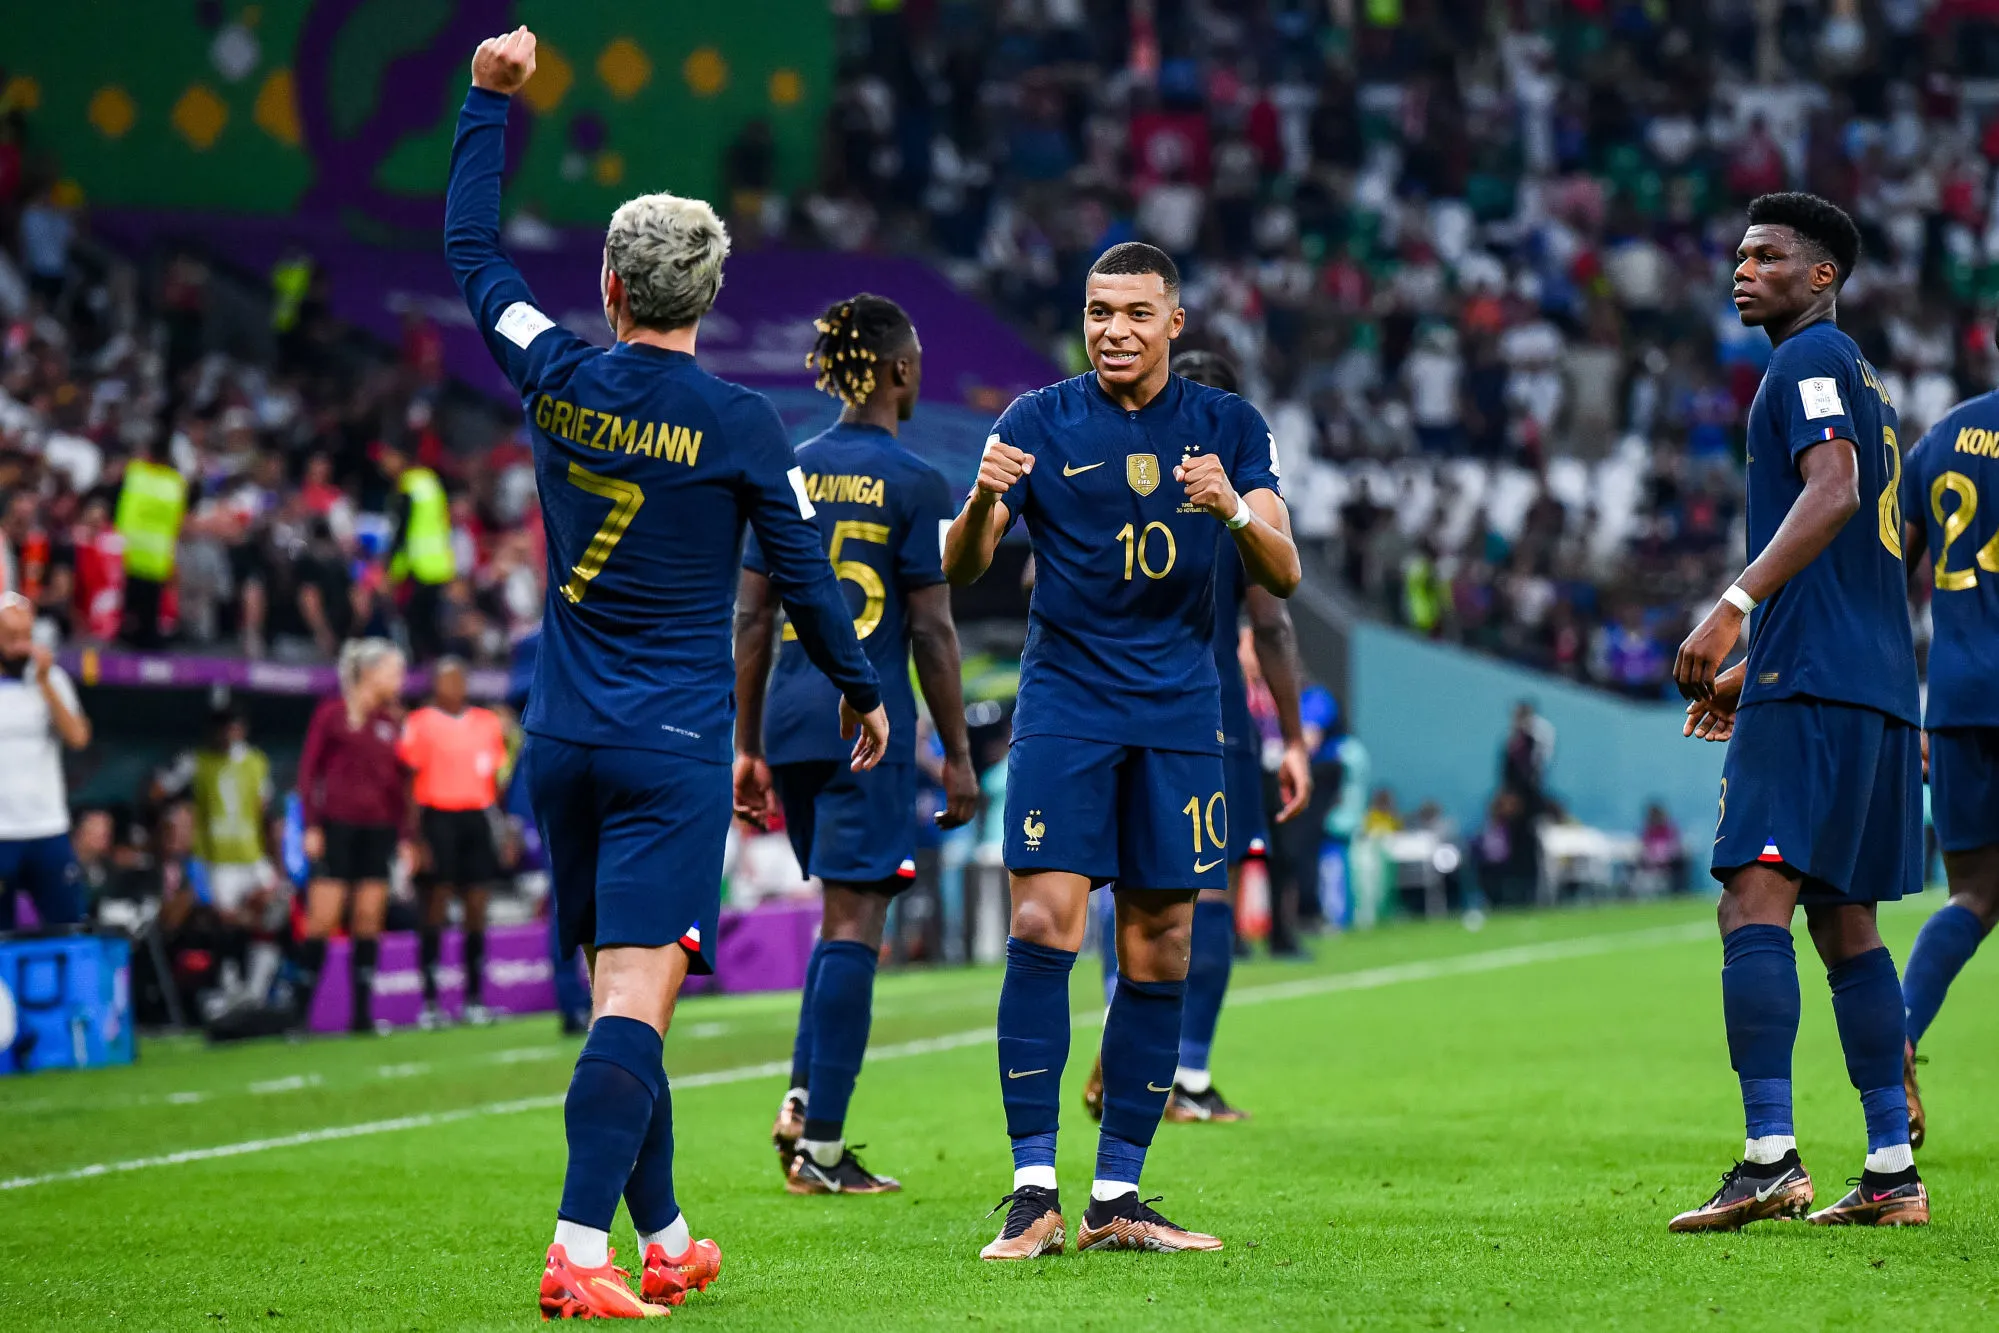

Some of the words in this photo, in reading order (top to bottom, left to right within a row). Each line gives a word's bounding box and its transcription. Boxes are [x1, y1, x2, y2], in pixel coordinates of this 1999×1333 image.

[536, 394, 703, 467] GRIEZMANN
[1954, 426, 1999, 459] KON
[559, 461, 645, 604] 7
[1115, 521, 1176, 580] 10
[781, 519, 891, 641] 5
[1182, 791, 1228, 853] 10
